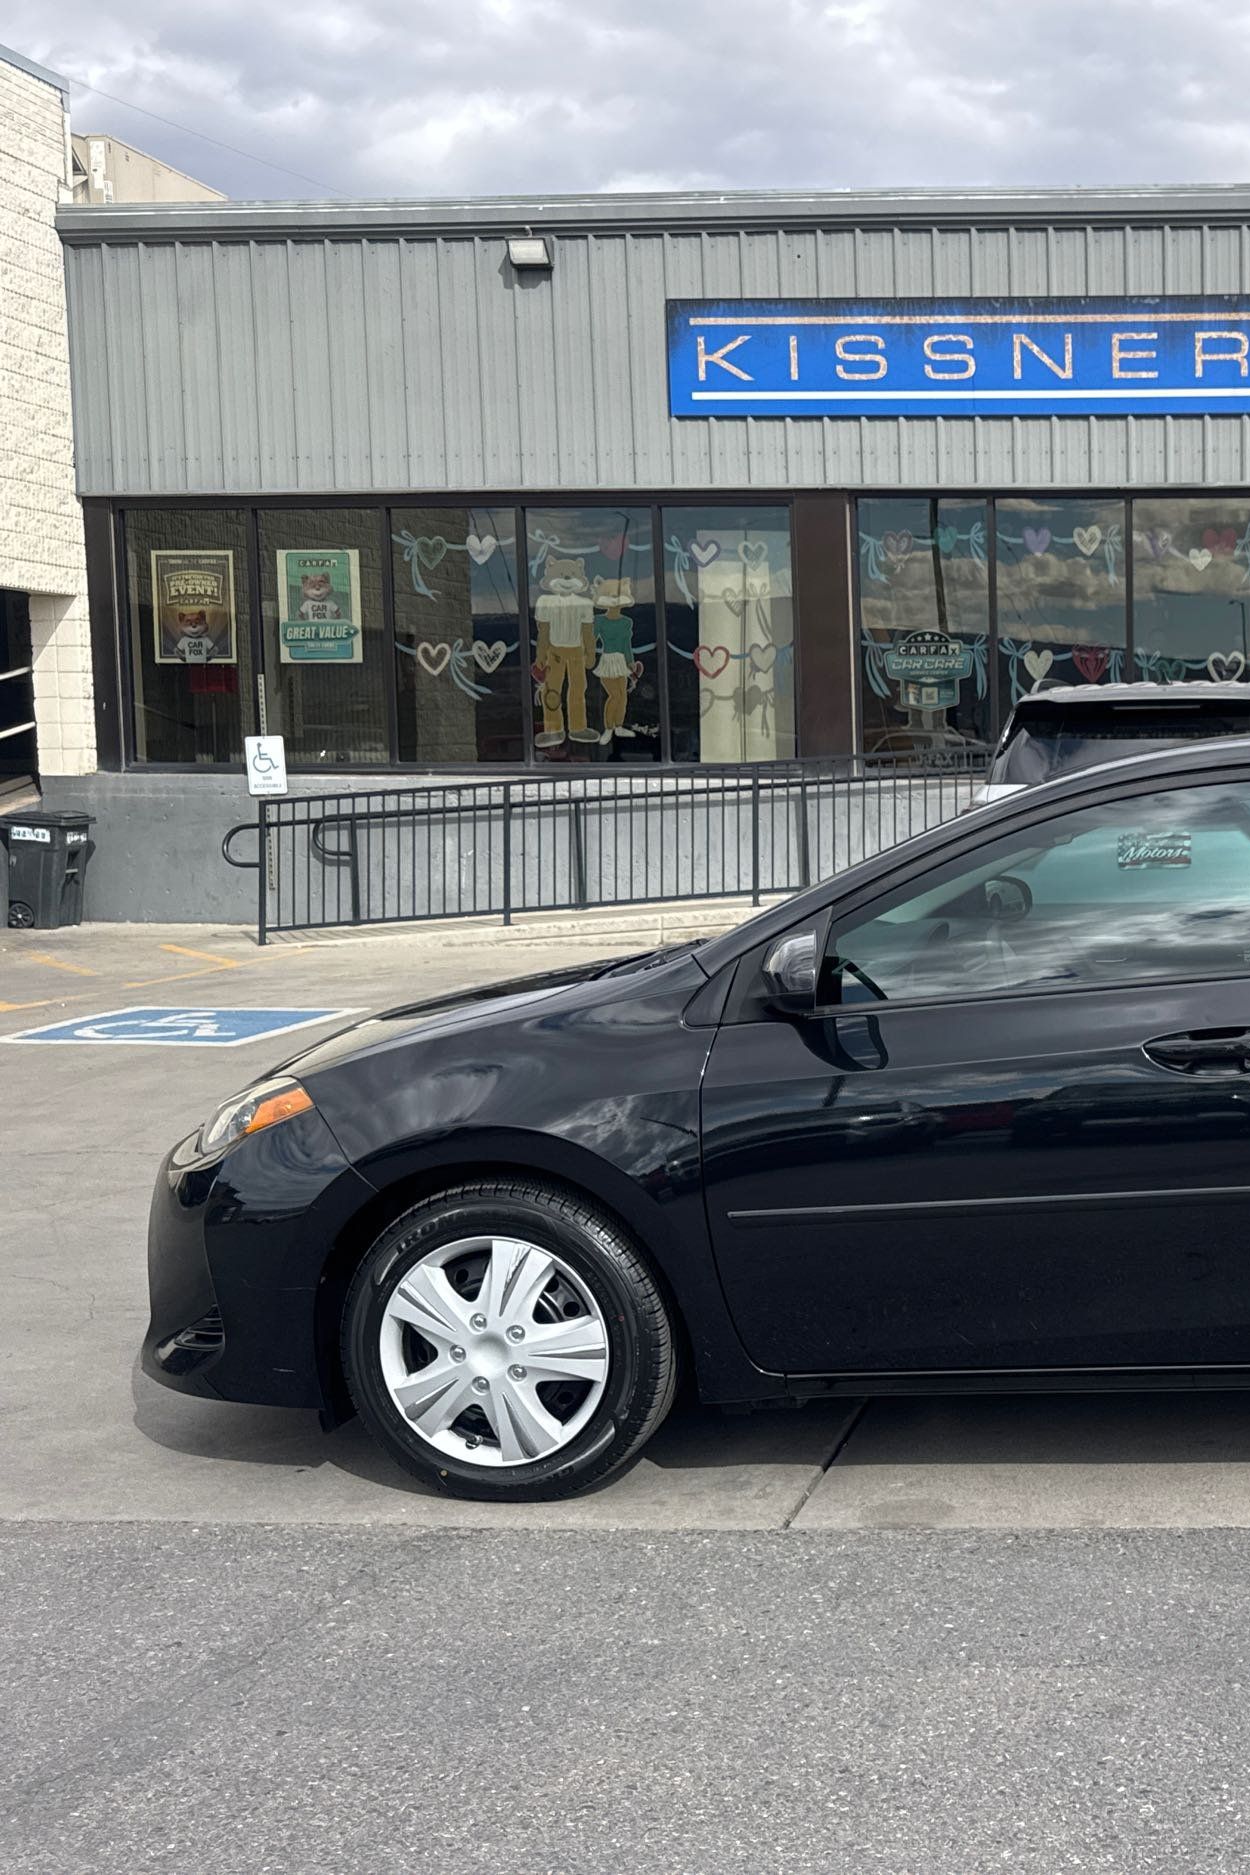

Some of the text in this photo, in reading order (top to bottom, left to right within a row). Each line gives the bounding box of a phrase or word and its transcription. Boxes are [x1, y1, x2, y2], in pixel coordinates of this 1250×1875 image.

[697, 331, 1250, 381] KISSNER
[170, 585, 218, 596] EVENT!
[312, 604, 327, 612] CAR
[287, 625, 348, 640] GREAT VALUE
[188, 641, 203, 649] CAR
[900, 645, 958, 656] CARFAX
[892, 659, 964, 670] CAR CARE
[1122, 846, 1183, 859] Motors
